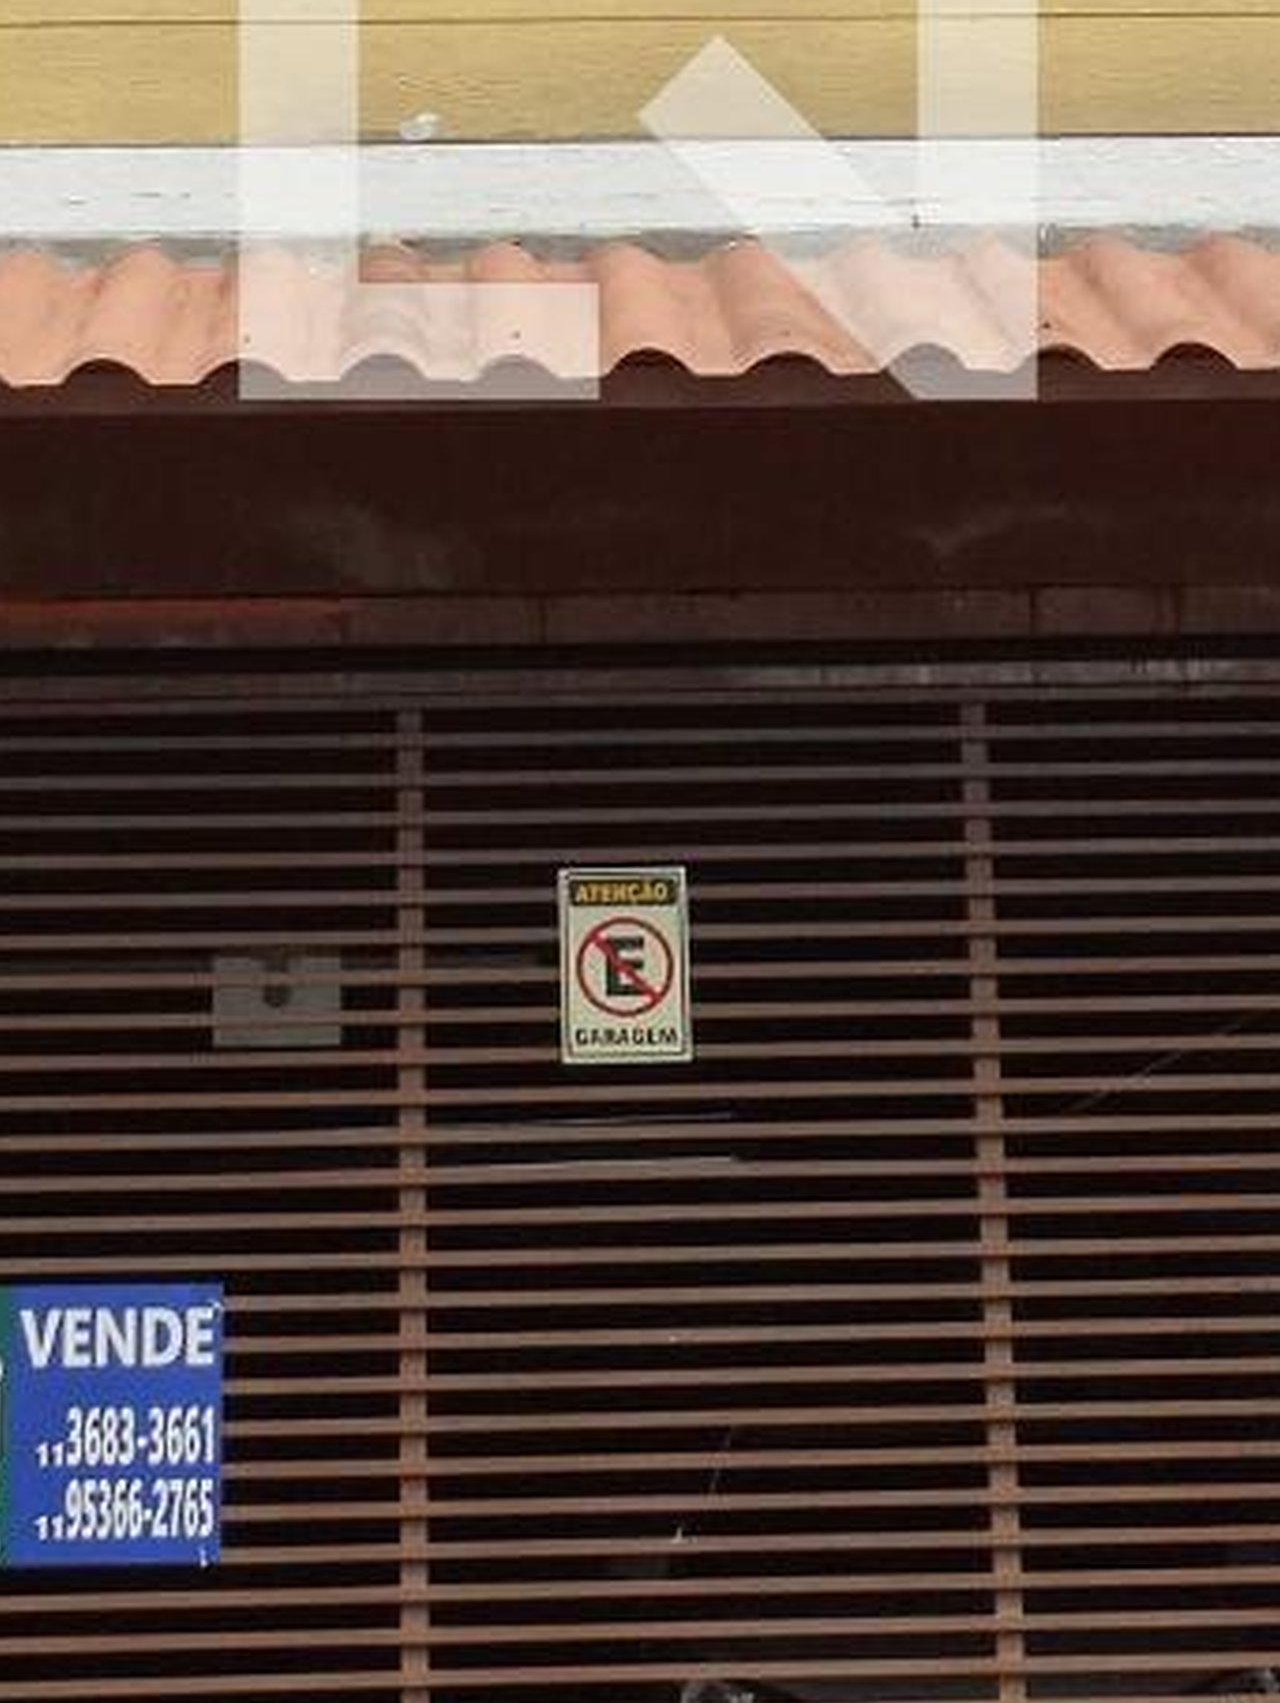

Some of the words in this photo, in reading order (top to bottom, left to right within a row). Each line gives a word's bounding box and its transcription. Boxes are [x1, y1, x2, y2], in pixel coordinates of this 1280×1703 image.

[575, 881, 668, 904] ATENÇÃO
[575, 1027, 679, 1045] GARAGEM
[20, 1306, 215, 1370] VENDE
